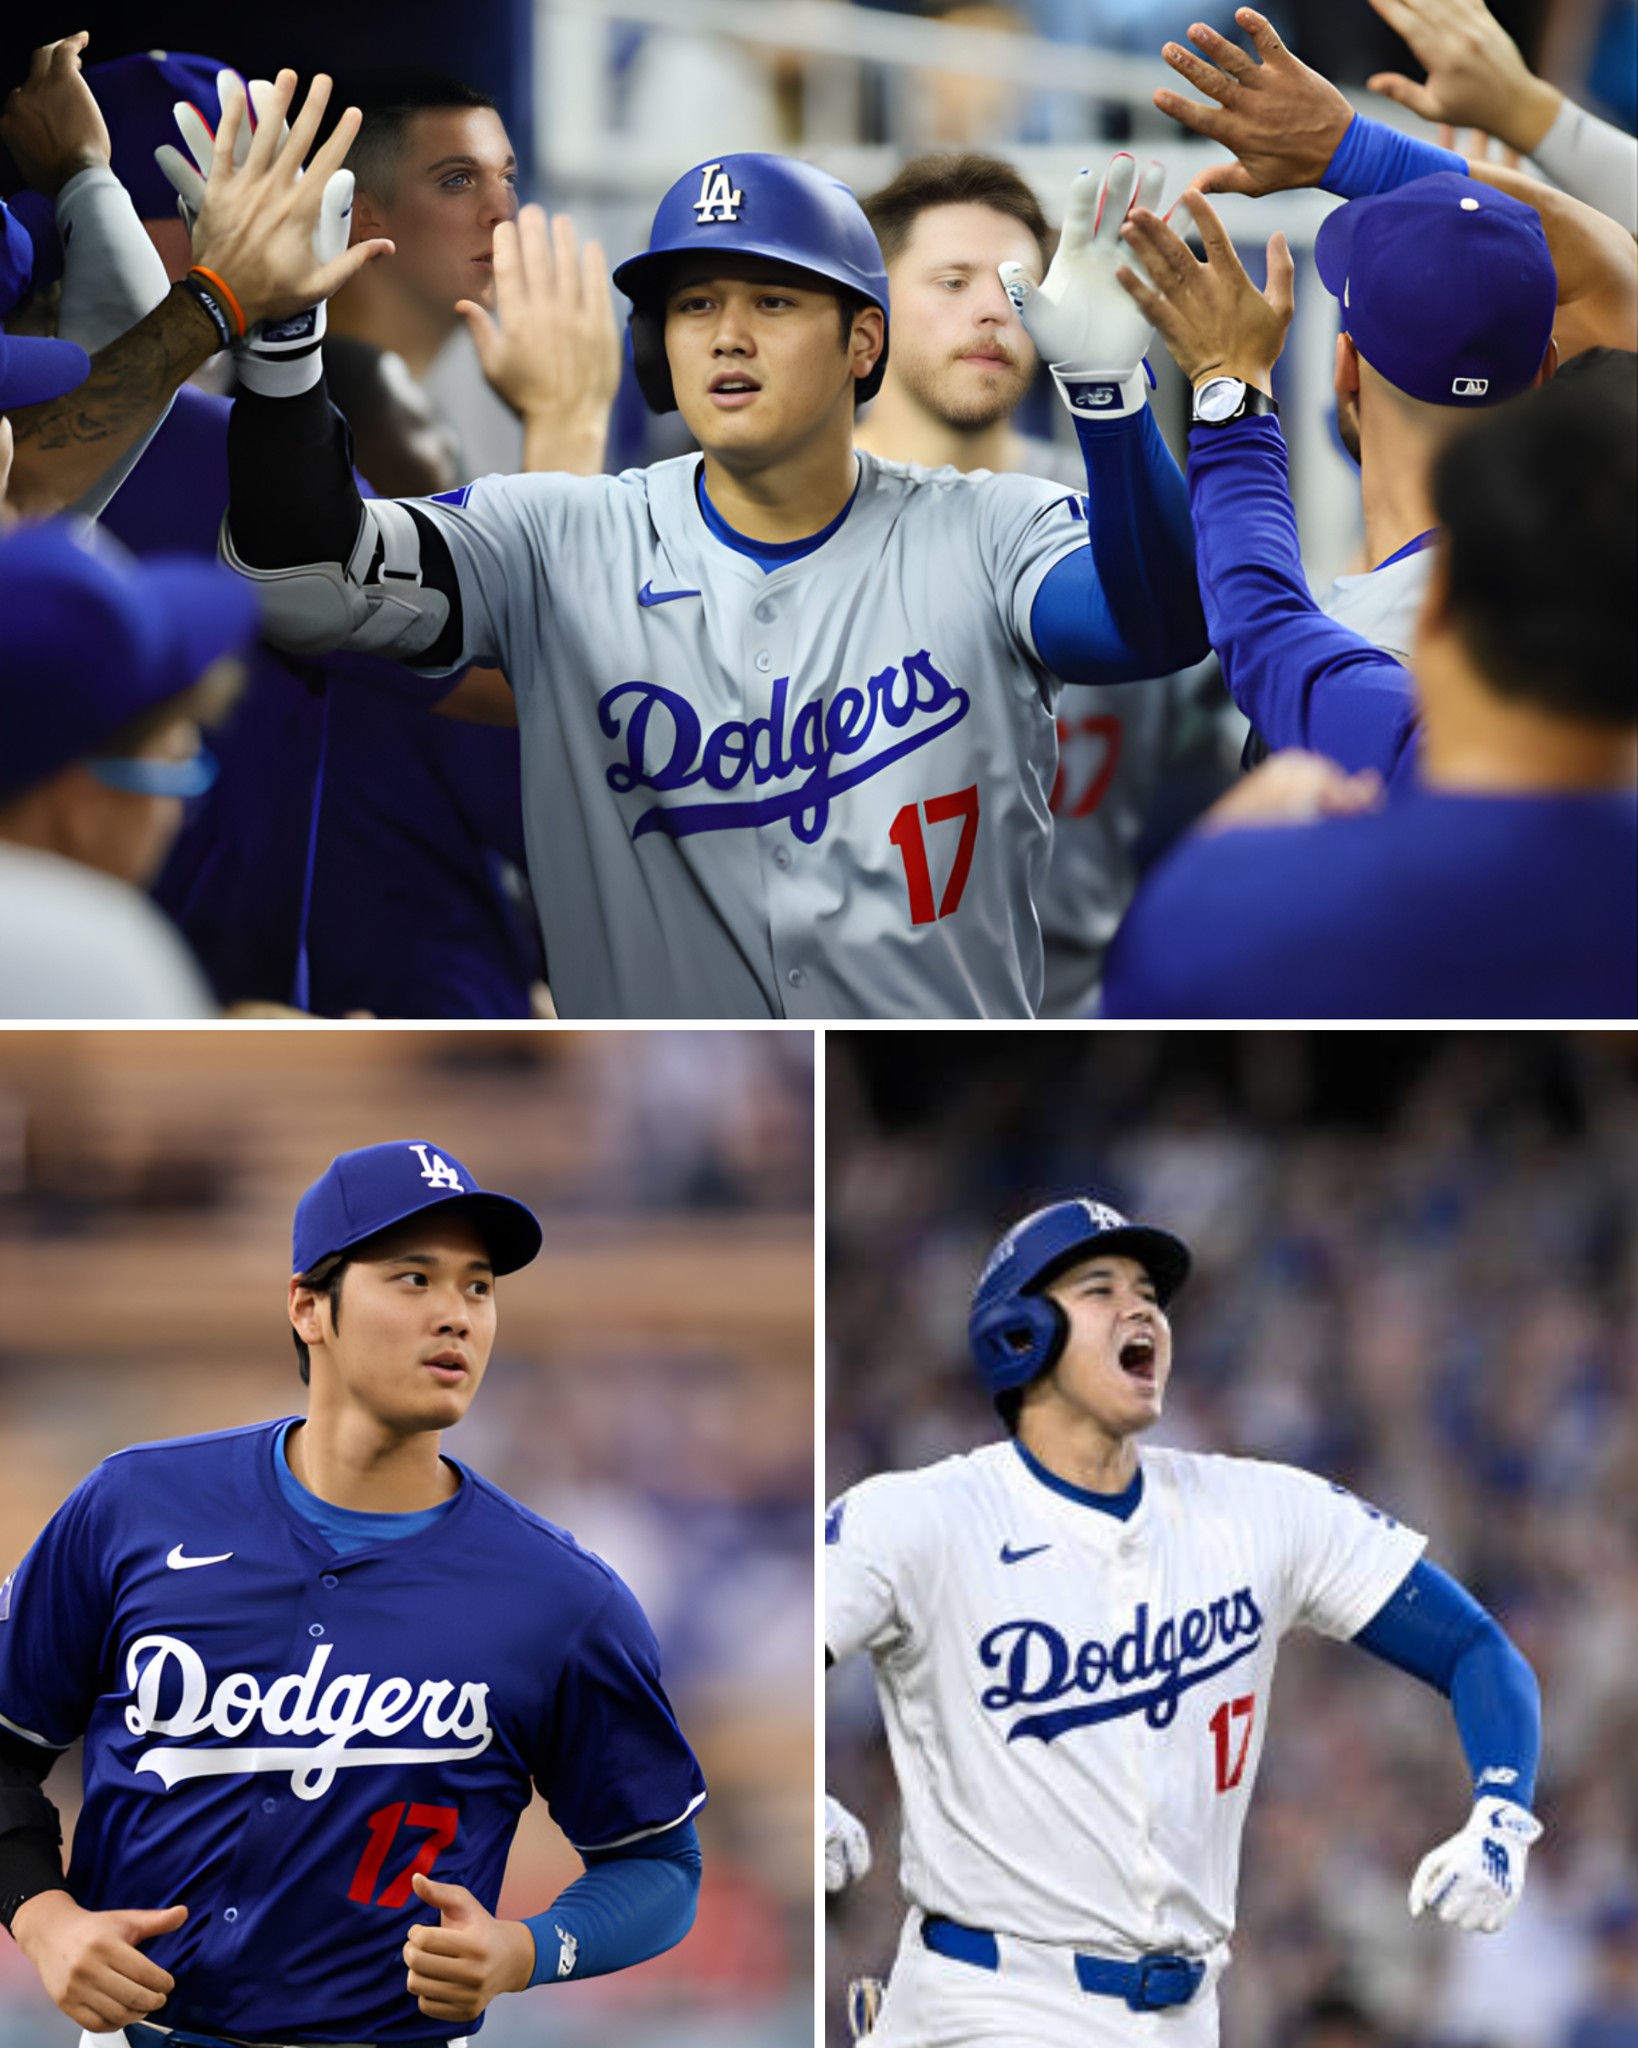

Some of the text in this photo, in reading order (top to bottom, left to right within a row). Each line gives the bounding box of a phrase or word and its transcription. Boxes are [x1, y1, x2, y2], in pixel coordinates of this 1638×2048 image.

[693, 163, 742, 223] LA
[599, 649, 970, 844] Dodgers
[889, 784, 980, 925] 17
[408, 1144, 465, 1193] LA
[125, 1635, 493, 1801] Dodgers
[979, 1586, 1263, 1745] Dodgers
[1208, 1693, 1256, 1793] 17
[347, 1801, 459, 1909] 17
